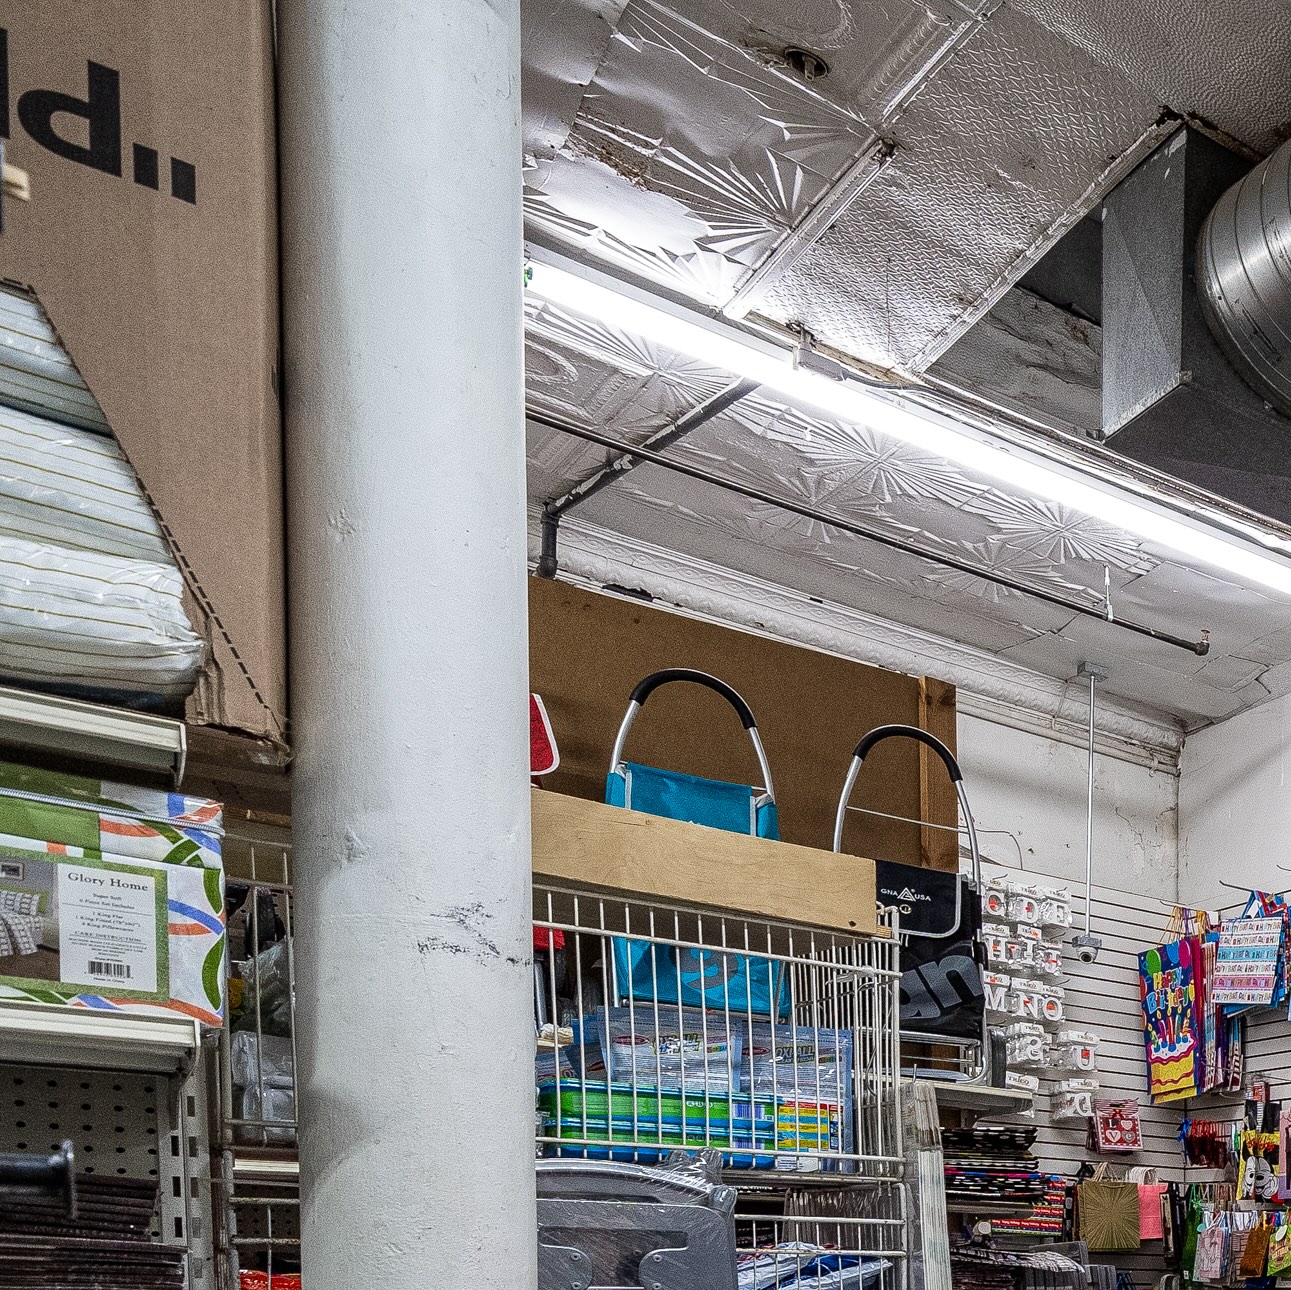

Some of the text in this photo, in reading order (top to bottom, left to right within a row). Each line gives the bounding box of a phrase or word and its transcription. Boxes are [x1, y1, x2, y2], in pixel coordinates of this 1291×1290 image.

[68, 873, 149, 892] Glory Home
[880, 887, 932, 902] GNA USA
